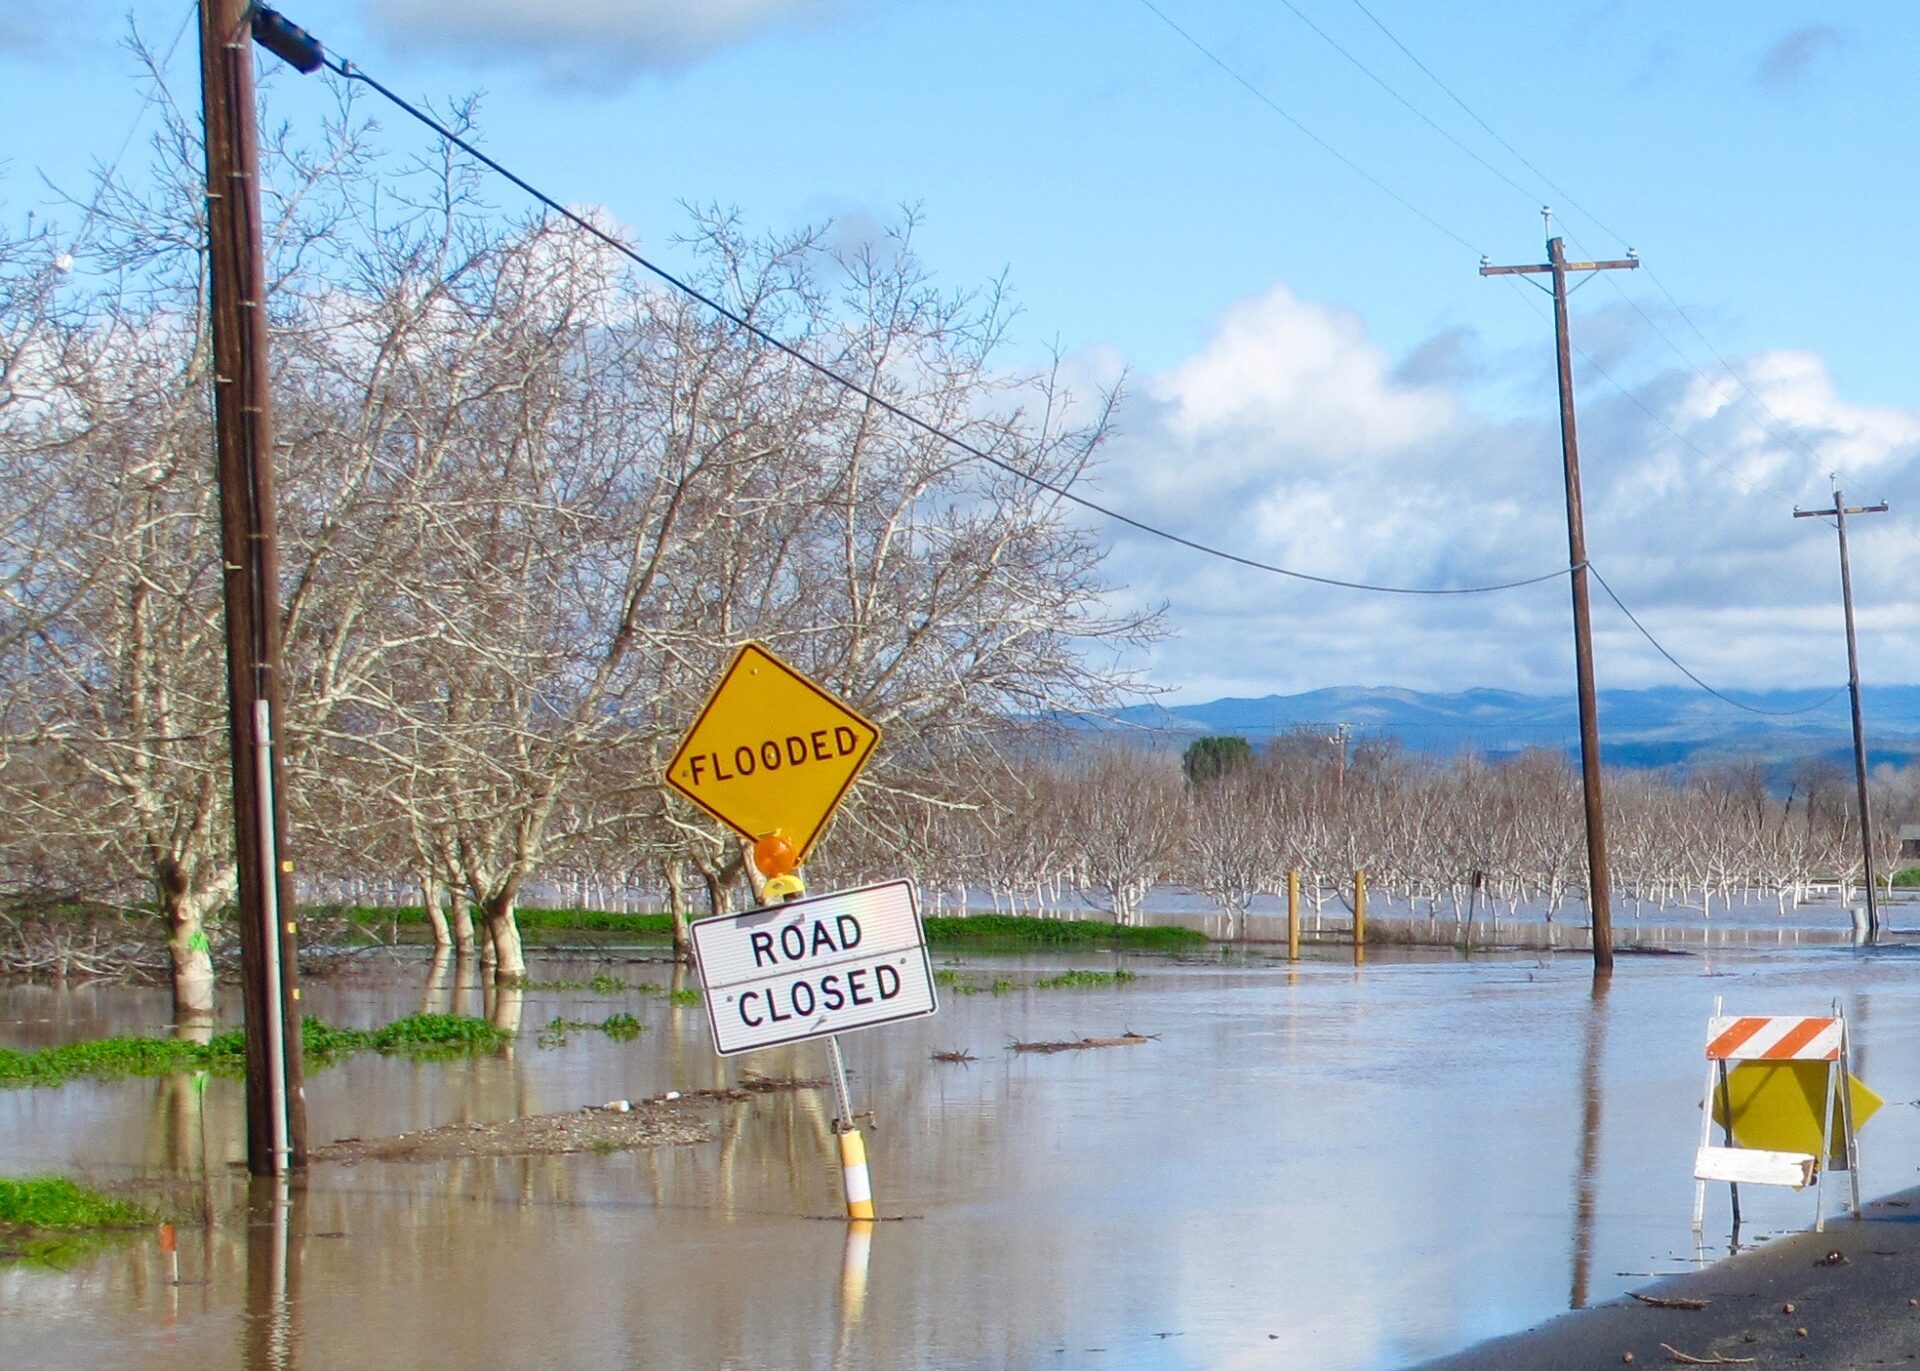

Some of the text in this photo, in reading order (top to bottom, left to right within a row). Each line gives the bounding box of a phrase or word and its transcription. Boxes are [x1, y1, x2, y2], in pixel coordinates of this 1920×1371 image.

[689, 725, 858, 786] FLOODED
[750, 914, 862, 967] ROAD
[738, 964, 901, 1027] CLOSED
